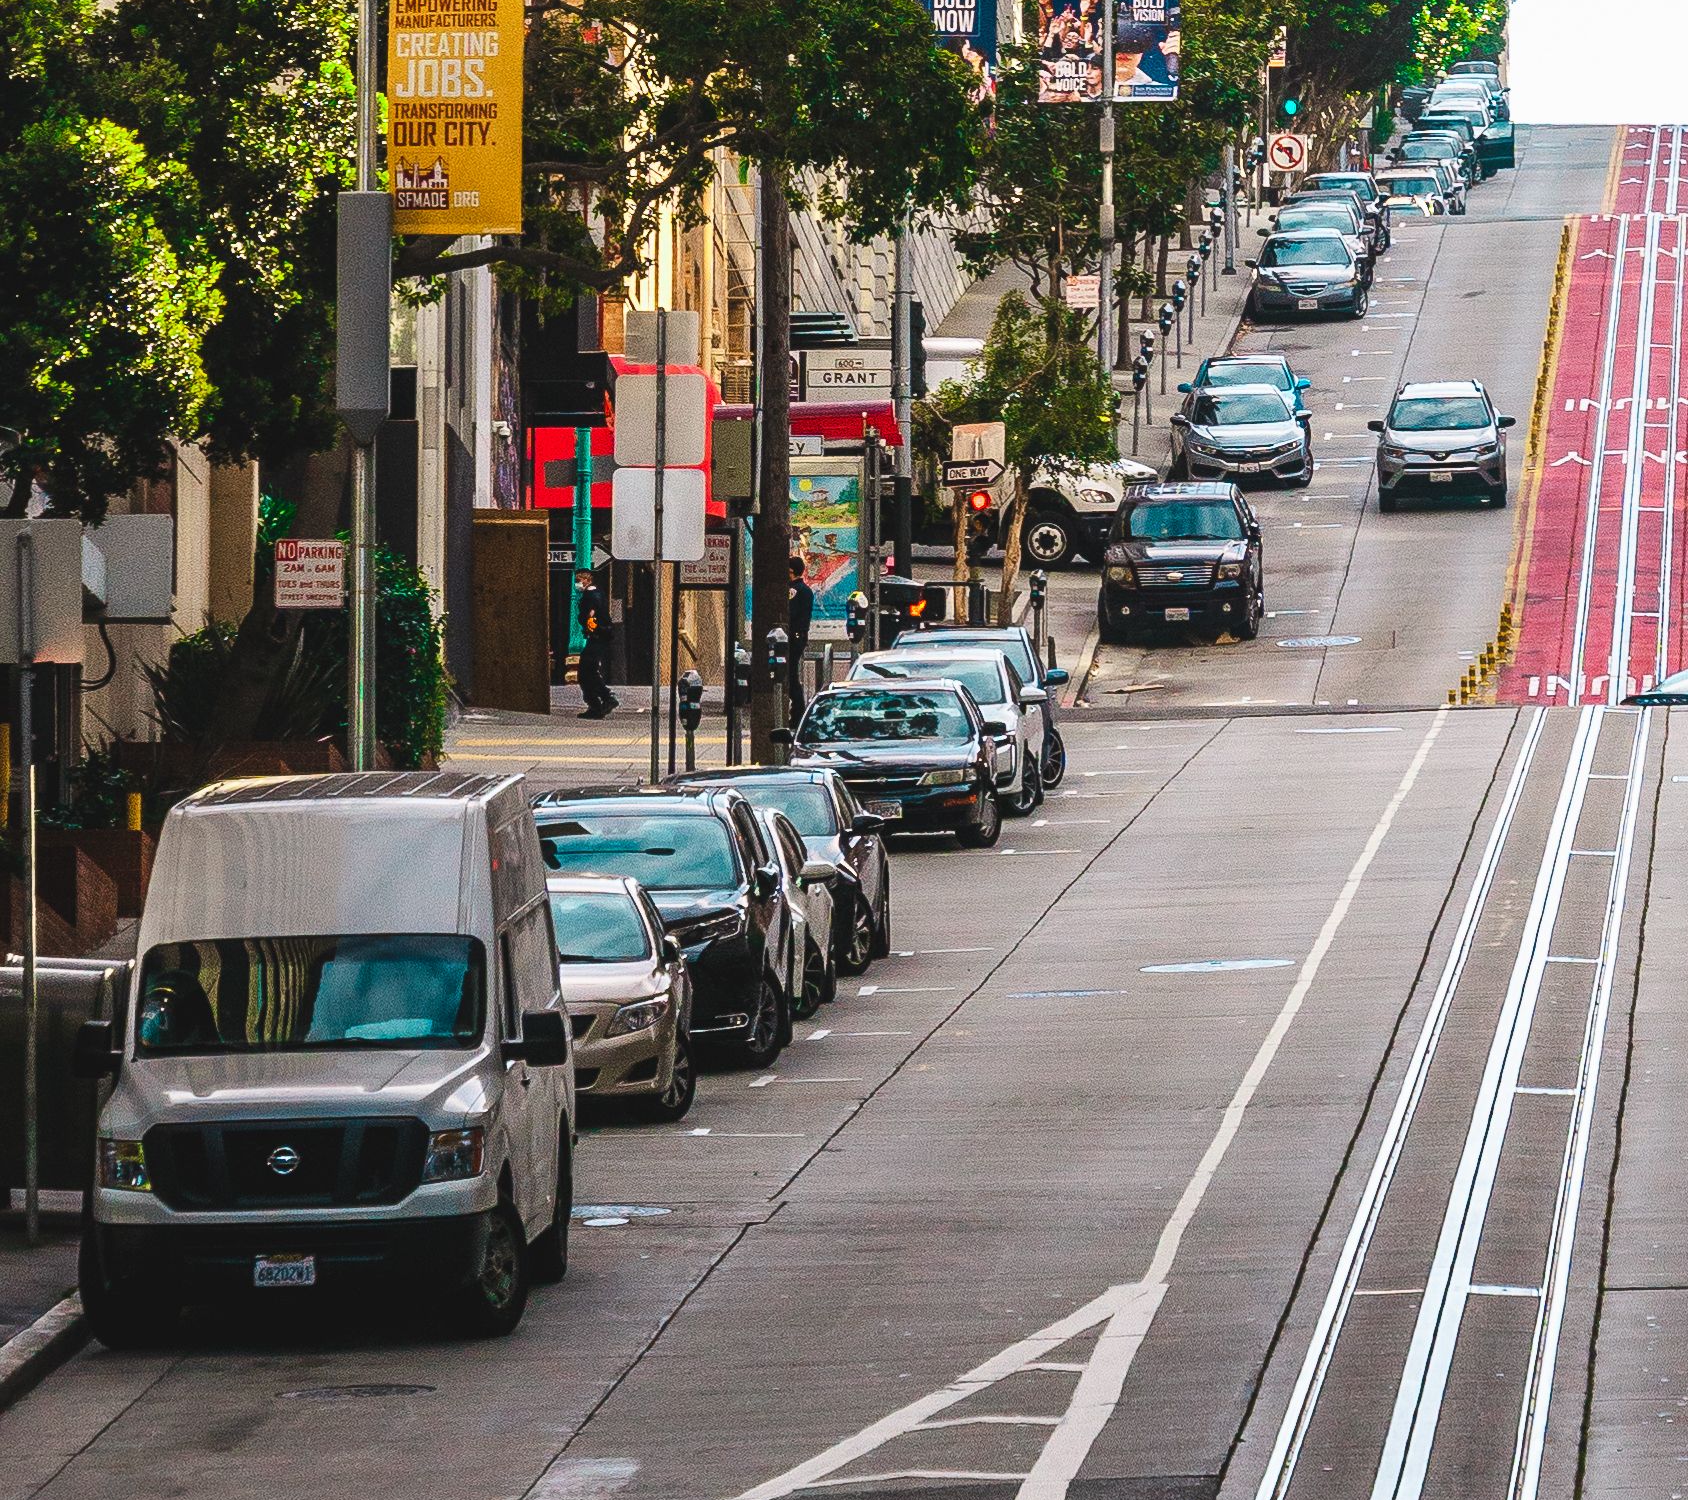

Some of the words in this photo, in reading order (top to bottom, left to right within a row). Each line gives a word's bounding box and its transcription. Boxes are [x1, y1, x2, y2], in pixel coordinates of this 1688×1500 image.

[395, 12, 500, 29] MANUFACTURERS.
[933, 9, 976, 33] NOW
[1133, 8, 1165, 22] VISION
[396, 31, 499, 57] CREATING
[1056, 61, 1087, 78] BOLD
[395, 59, 494, 98] JOBS.
[1056, 77, 1087, 92] VOICE
[394, 102, 498, 120] TRANSFORMING
[394, 121, 437, 147] OUR
[444, 121, 497, 147] CITY.
[398, 191, 447, 208] SFMADE
[450, 191, 481, 208] .ORG
[822, 372, 878, 384] GRANT
[949, 468, 968, 479] ONE
[970, 467, 988, 477] WAY
[278, 542, 296, 559] NO
[299, 546, 342, 559] PARKING
[706, 538, 730, 548] RKING
[283, 564, 304, 573] 2AM
[314, 564, 336, 573] 6AM
[277, 580, 297, 588] TUES
[316, 580, 340, 588] THURS
